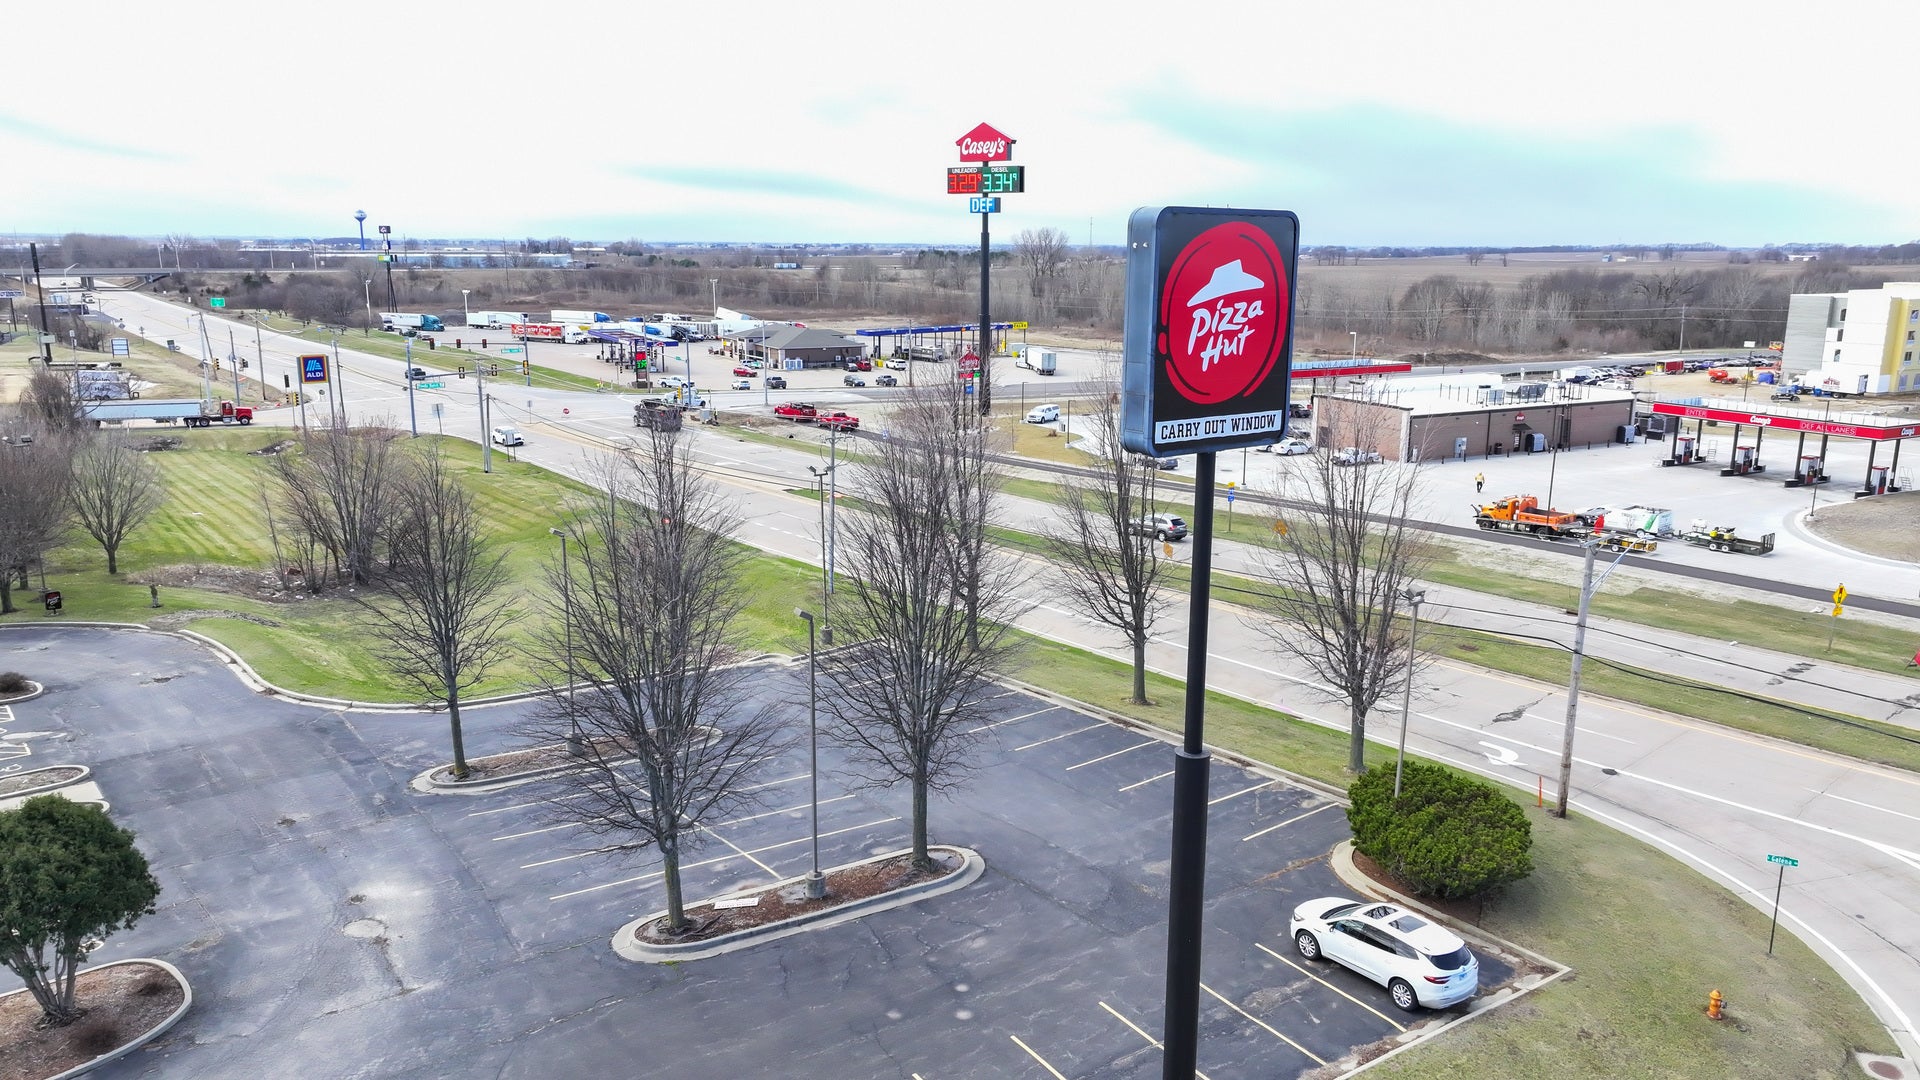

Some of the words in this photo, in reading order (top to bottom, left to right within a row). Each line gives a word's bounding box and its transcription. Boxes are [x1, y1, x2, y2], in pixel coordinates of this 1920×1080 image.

[961, 137, 1005, 157] Casey's
[971, 198, 993, 213] DEF
[1188, 299, 1264, 355] Pizza
[1200, 325, 1255, 372] Hut
[1686, 408, 1707, 418] ENTER
[1161, 422, 1200, 440] CARRY
[1203, 418, 1227, 435] OUT
[1230, 413, 1277, 433] WINDOW
[1801, 421, 1815, 430] DEF
[1816, 424, 1829, 432] ALL
[1830, 425, 1856, 436] LANES
